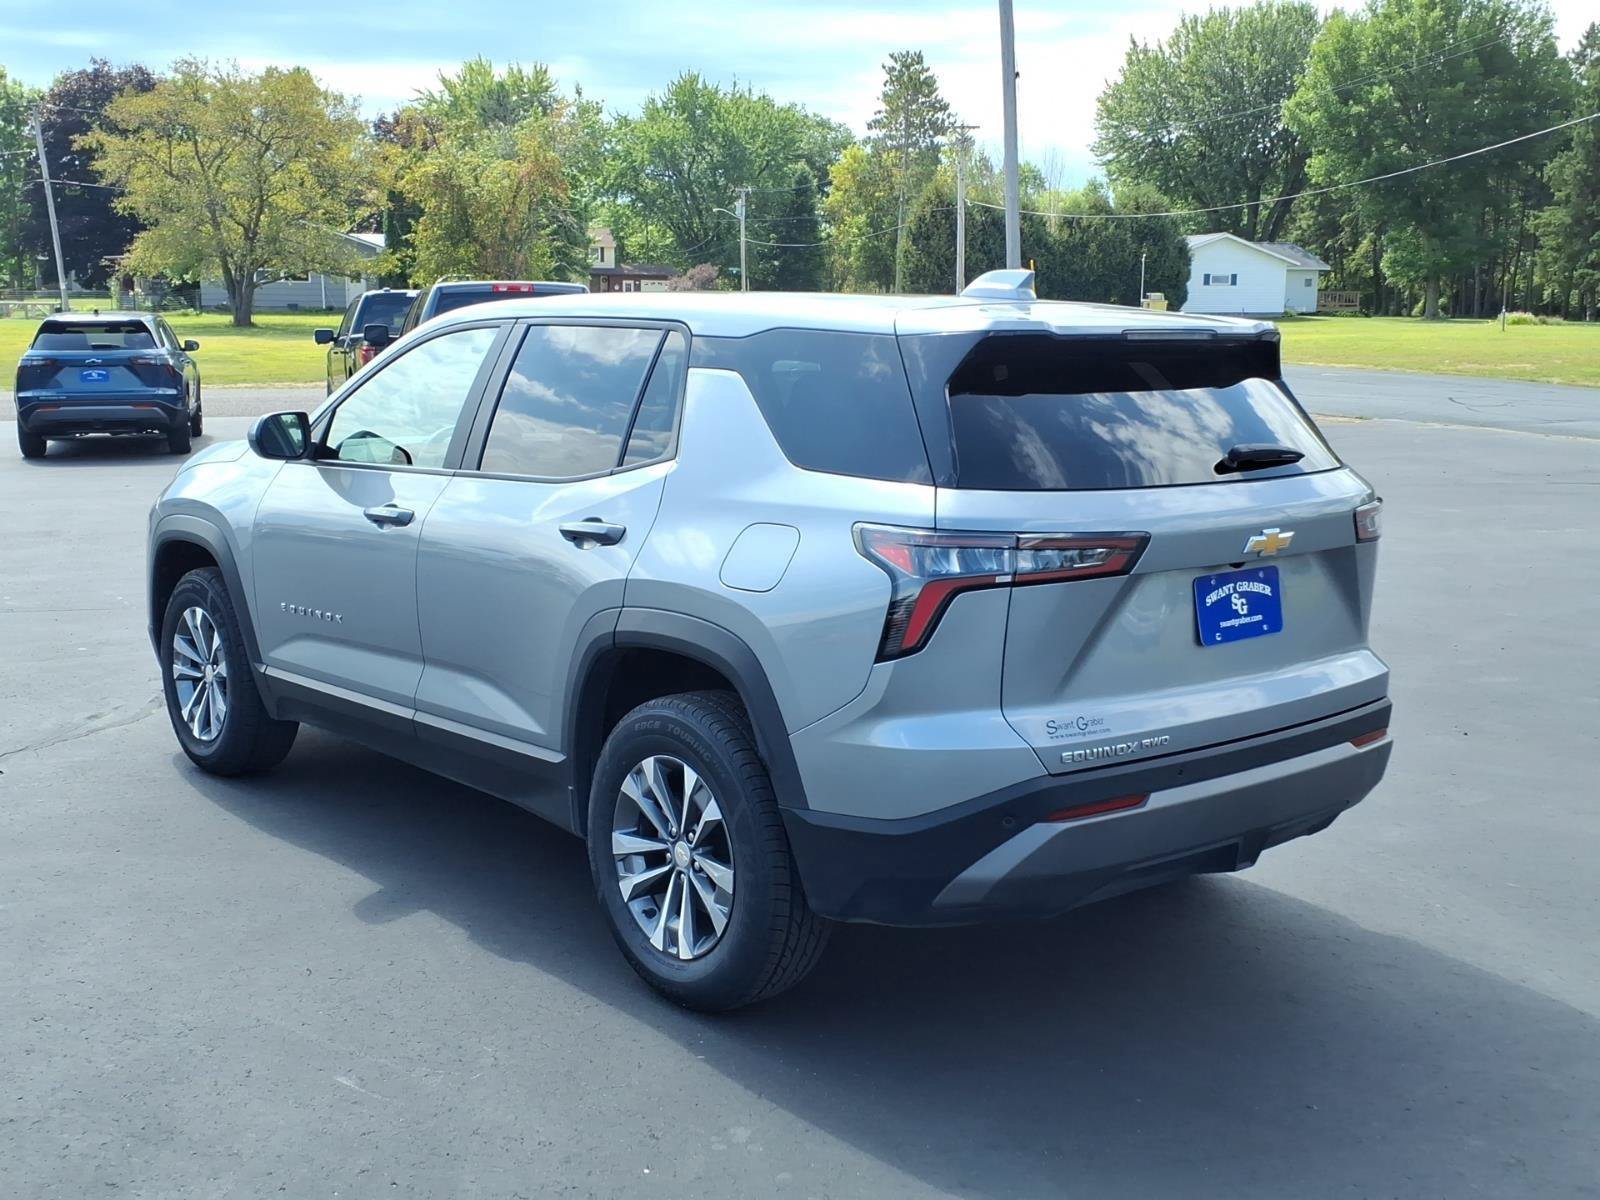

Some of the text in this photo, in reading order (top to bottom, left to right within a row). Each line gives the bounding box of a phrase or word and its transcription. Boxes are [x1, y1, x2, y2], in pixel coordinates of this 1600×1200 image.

[1206, 581, 1272, 607] SWANT GRABER
[280, 602, 343, 624] EQUINOX
[1219, 614, 1263, 628] swantgraber.com
[1046, 720, 1075, 735] Swant
[634, 720, 712, 761] EDGE TOURING
[1061, 741, 1138, 763] EQUINOX
